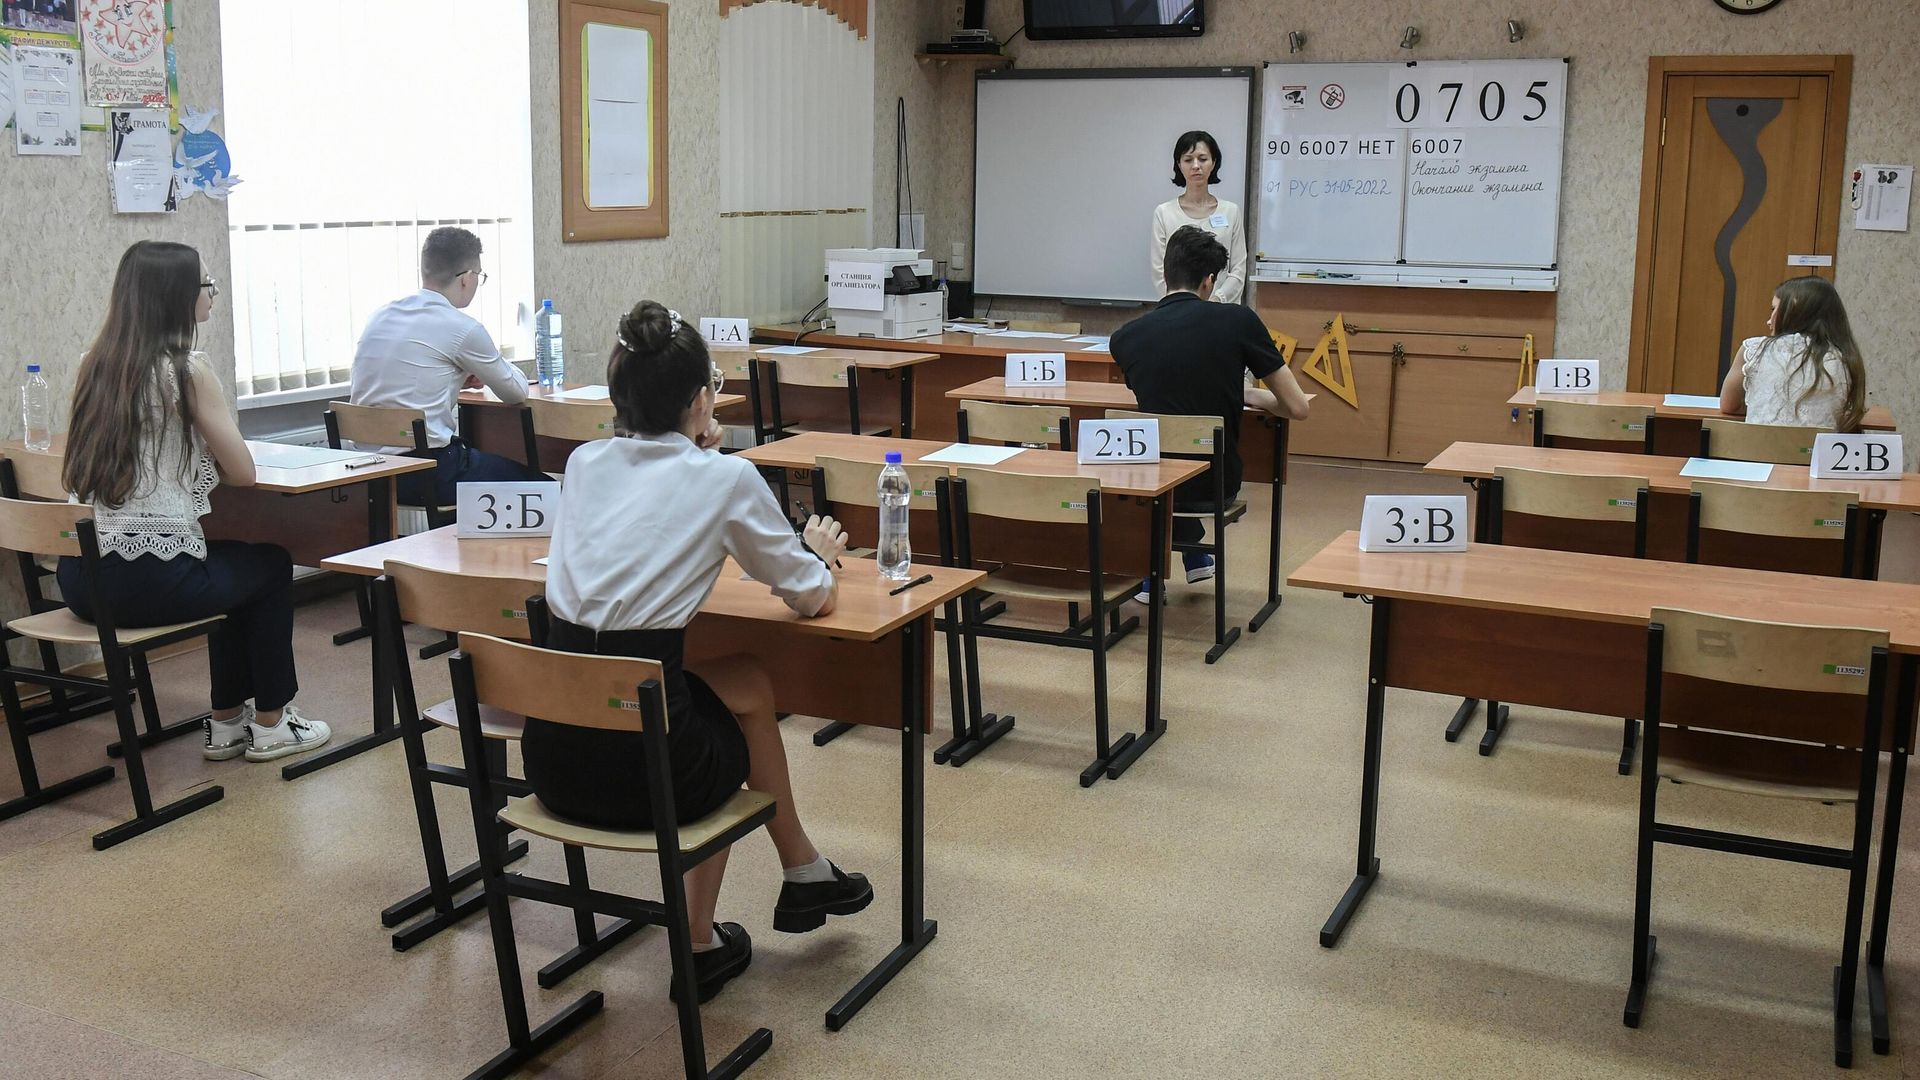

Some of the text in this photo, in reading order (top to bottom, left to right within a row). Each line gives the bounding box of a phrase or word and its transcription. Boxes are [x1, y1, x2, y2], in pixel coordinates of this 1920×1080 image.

[133, 120, 167, 129] ГРАМОТА
[1267, 139, 1463, 156] 90 6007 НЕТ 6007
[1411, 160, 1529, 182] Начало экзамена
[1289, 179, 1319, 198] РУС
[1411, 180, 1545, 200] Окончание экзамена
[831, 281, 881, 290] ОРГАНИЗАТОРА
[840, 273, 872, 281] СТАНЦИЯ
[710, 324, 743, 342] 1:А
[1020, 360, 1056, 381] 1:Б
[1552, 367, 1591, 388] 1:В
[1095, 429, 1147, 457] 2:Б
[1830, 442, 1890, 472] 2:В
[477, 494, 545, 529] 3:Б
[1386, 507, 1455, 544] 3:В
[1836, 666, 1865, 676] 1135292
